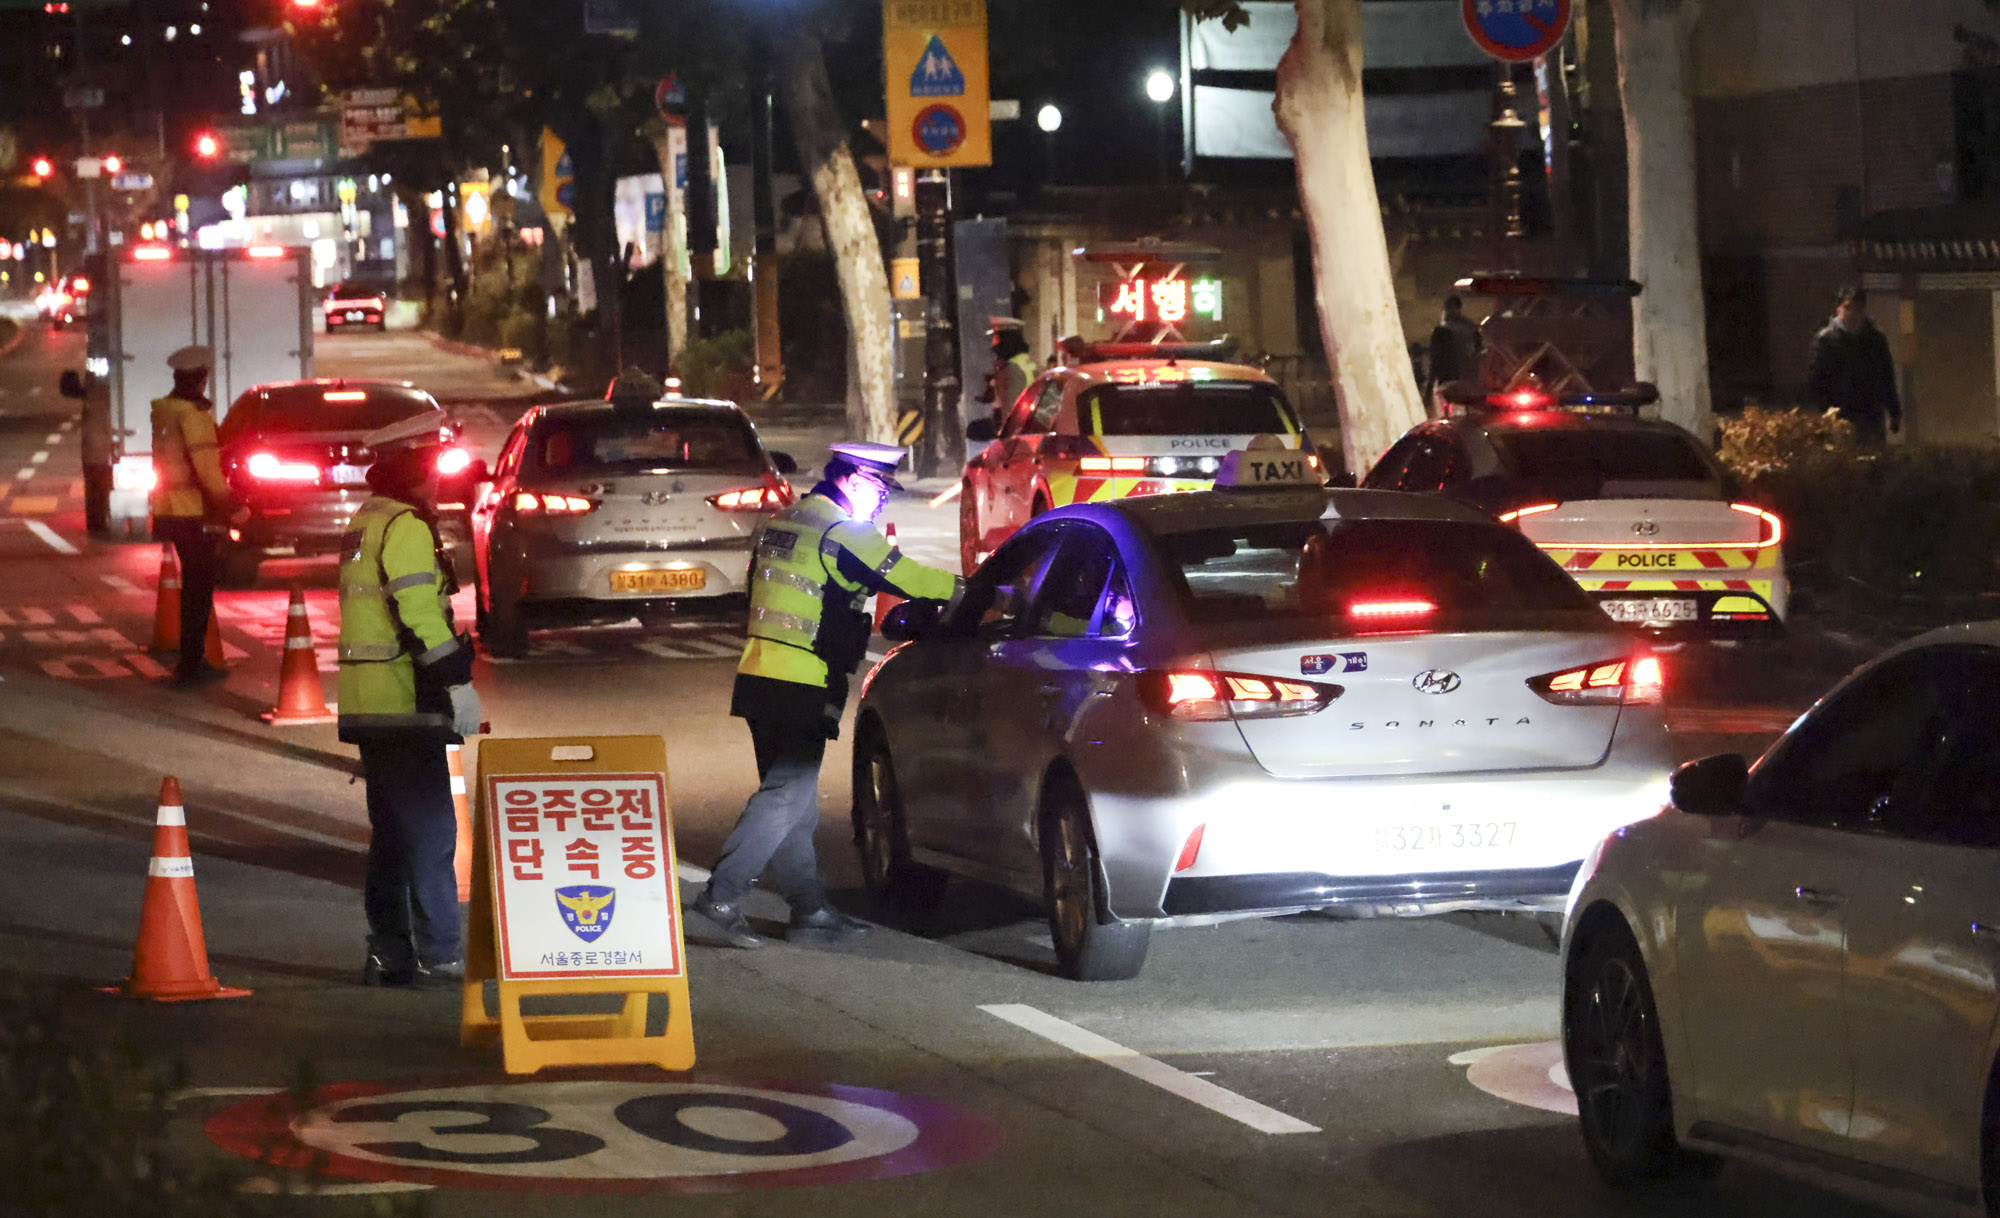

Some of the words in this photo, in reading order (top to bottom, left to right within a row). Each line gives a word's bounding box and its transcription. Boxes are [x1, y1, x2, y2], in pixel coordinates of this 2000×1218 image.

[1170, 438, 1231, 449] POLICE
[1250, 460, 1304, 481] TAXI
[1617, 553, 1677, 567] POLICE
[660, 573, 698, 588] 4380
[1652, 602, 1692, 618] 6625
[1304, 656, 1324, 670] 서울
[1347, 655, 1367, 668] 개인
[1349, 716, 1531, 731] SONATA
[504, 788, 653, 833] 음주운전
[1450, 821, 1517, 848] 3327
[575, 925, 602, 933] POLICE
[540, 950, 643, 967] 서울종로경찰서
[331, 1092, 856, 1165] 30
